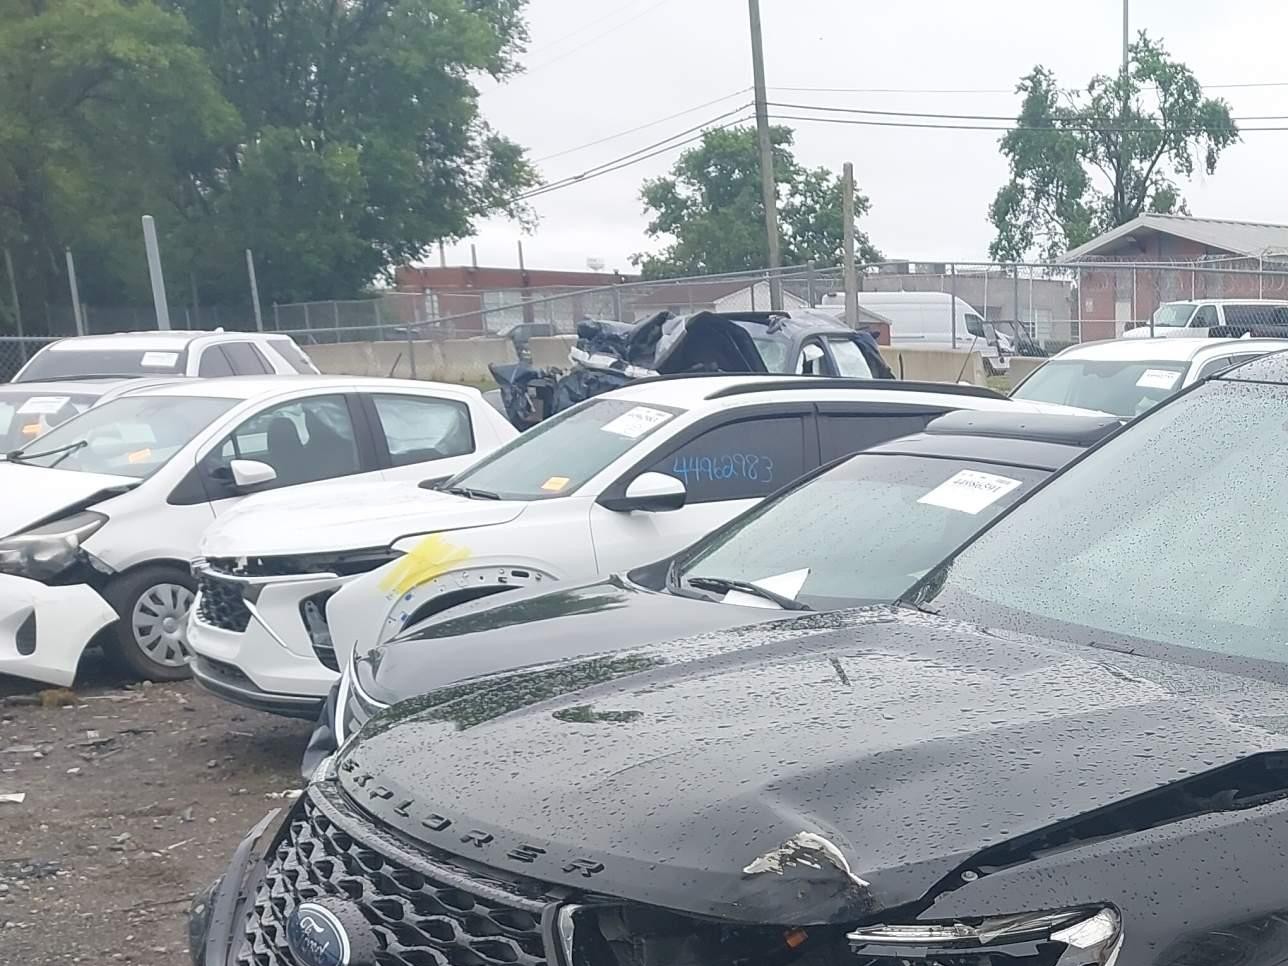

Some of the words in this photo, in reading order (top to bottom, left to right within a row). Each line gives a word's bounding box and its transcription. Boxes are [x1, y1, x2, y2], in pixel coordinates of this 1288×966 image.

[672, 453, 774, 487] 44962983
[341, 759, 606, 878] EXPLORER
[299, 916, 331, 954] Ford
